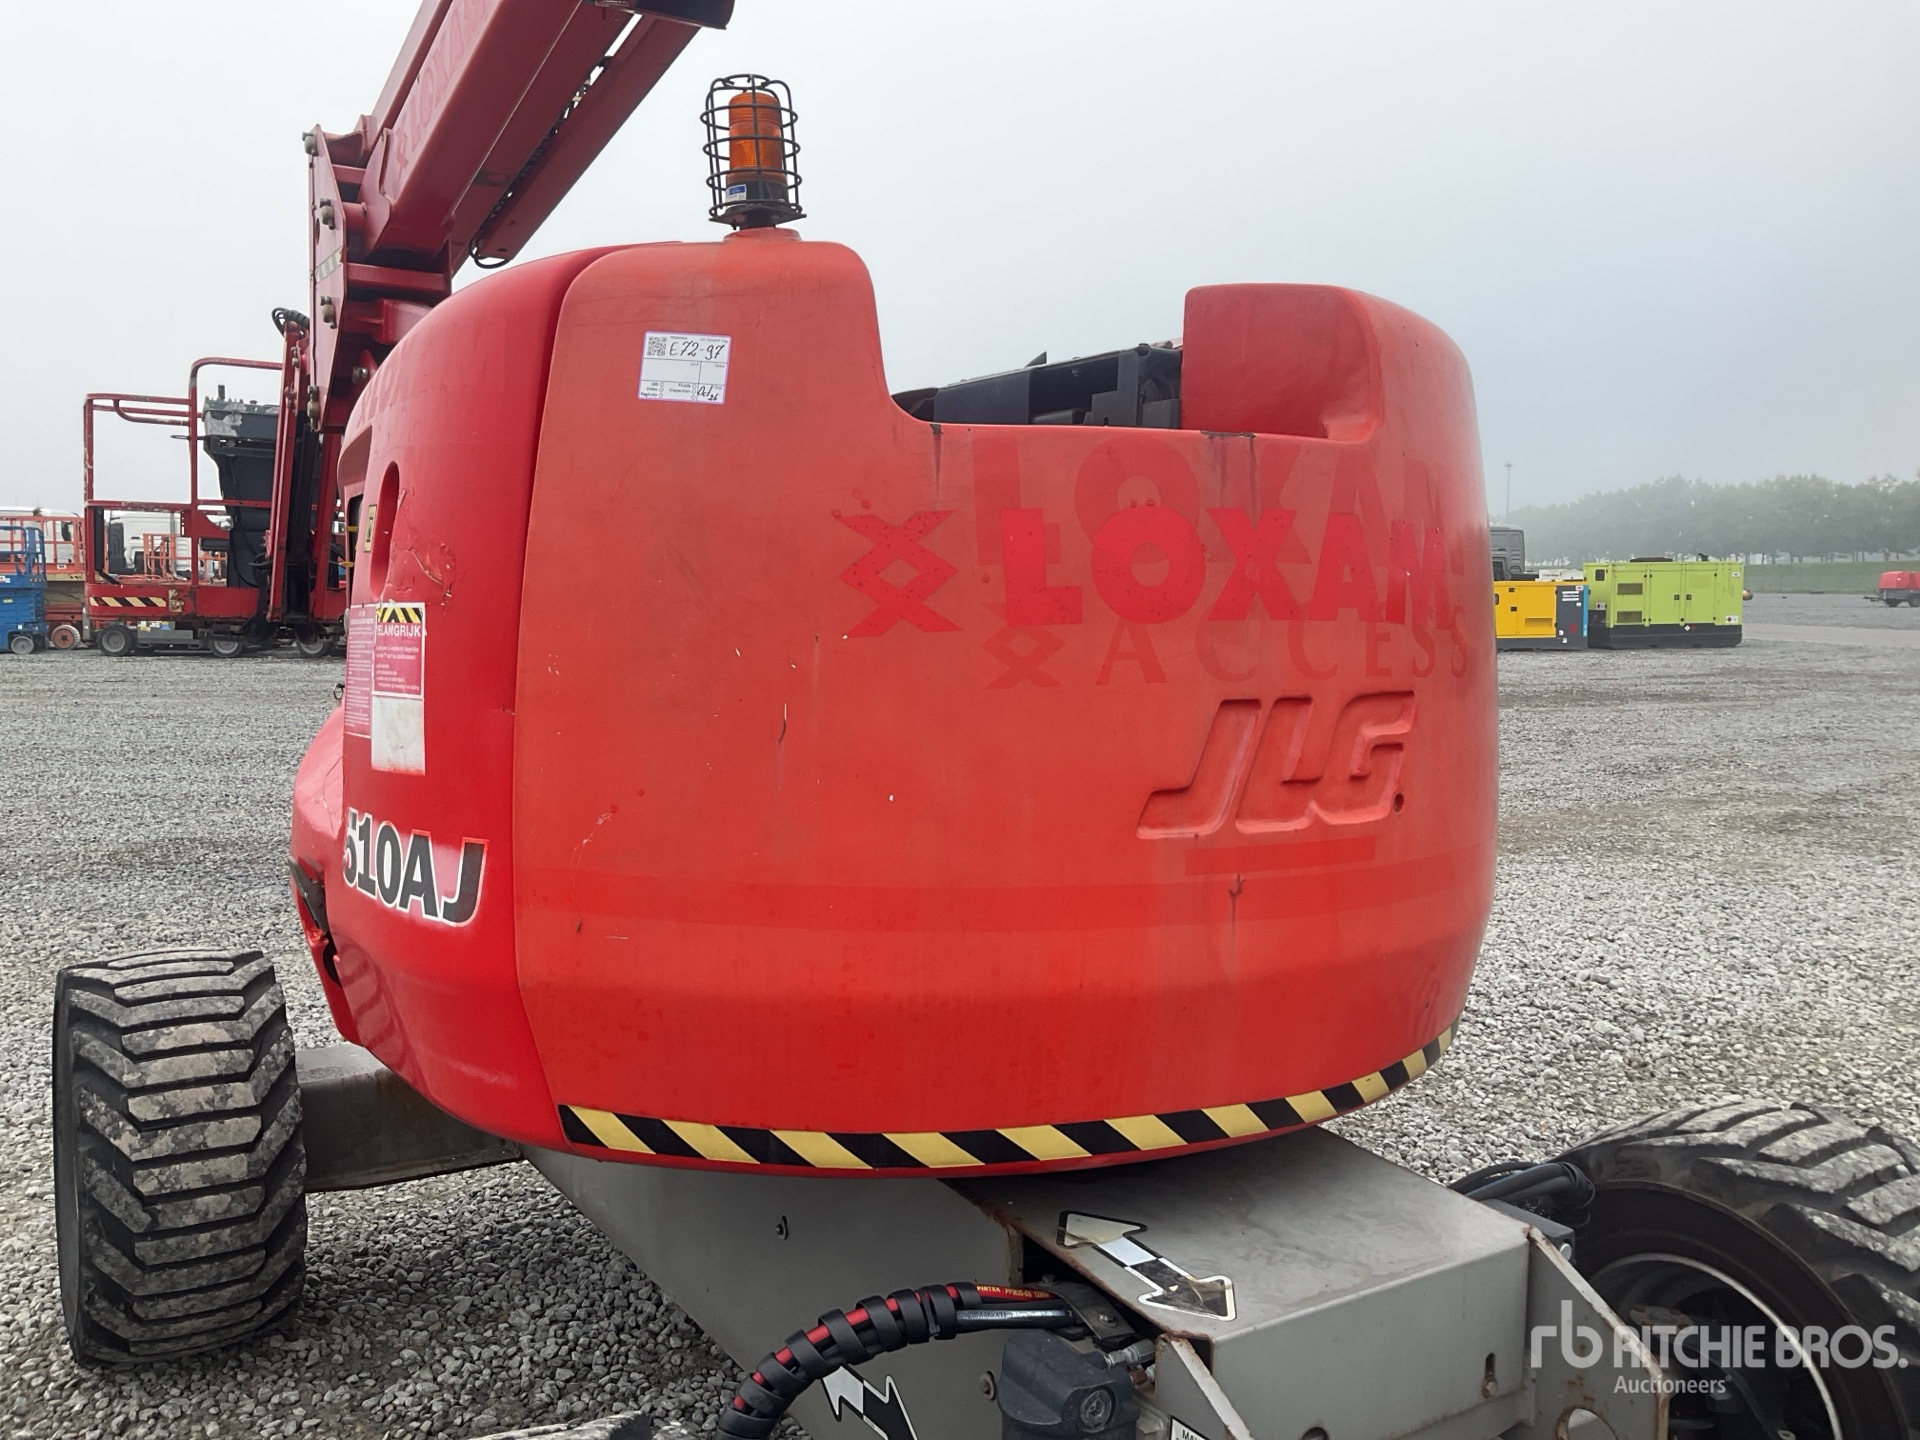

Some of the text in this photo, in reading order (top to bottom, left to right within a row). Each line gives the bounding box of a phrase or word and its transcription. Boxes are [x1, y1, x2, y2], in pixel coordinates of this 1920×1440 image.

[1000, 504, 1451, 630] LOXAM
[1096, 602, 1468, 685] ACCESS
[1136, 690, 1416, 840] JLG
[344, 808, 489, 926] 510AJ
